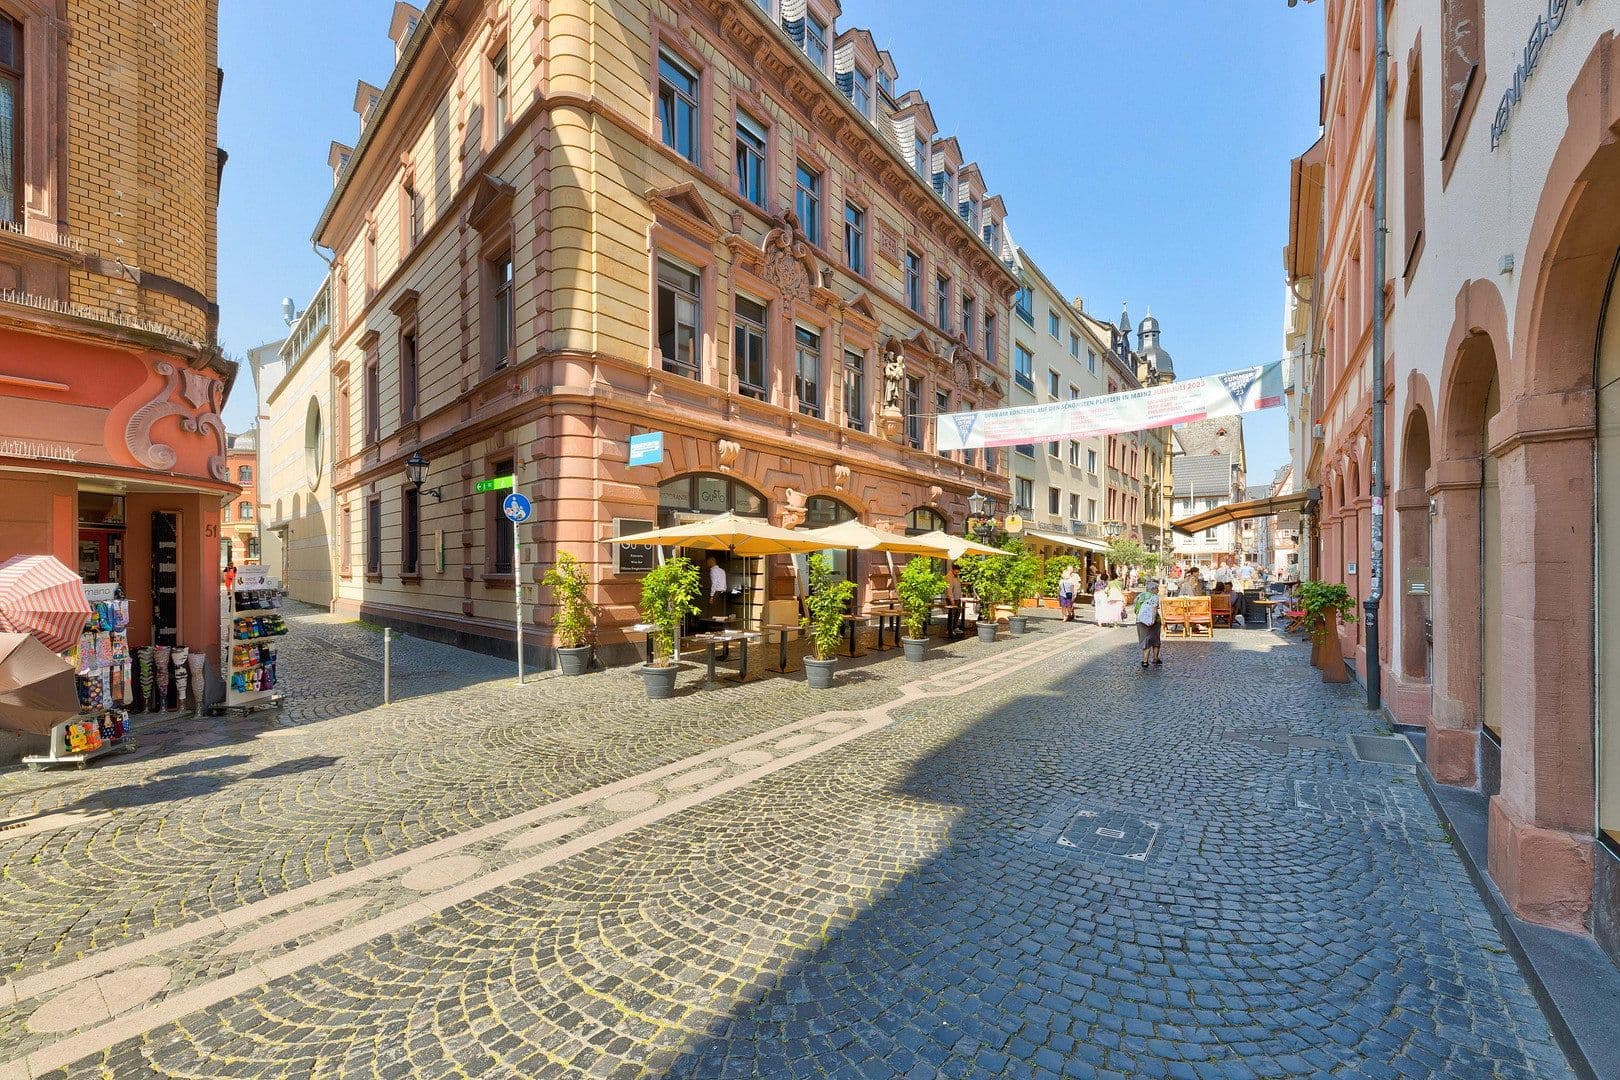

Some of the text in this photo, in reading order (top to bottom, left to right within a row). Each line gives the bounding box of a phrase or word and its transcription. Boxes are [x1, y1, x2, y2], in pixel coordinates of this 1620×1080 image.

[1130, 390, 1151, 399] MAINZ
[1187, 380, 1206, 390] 2023
[701, 489, 726, 503] GUSTO
[205, 524, 217, 538] 51
